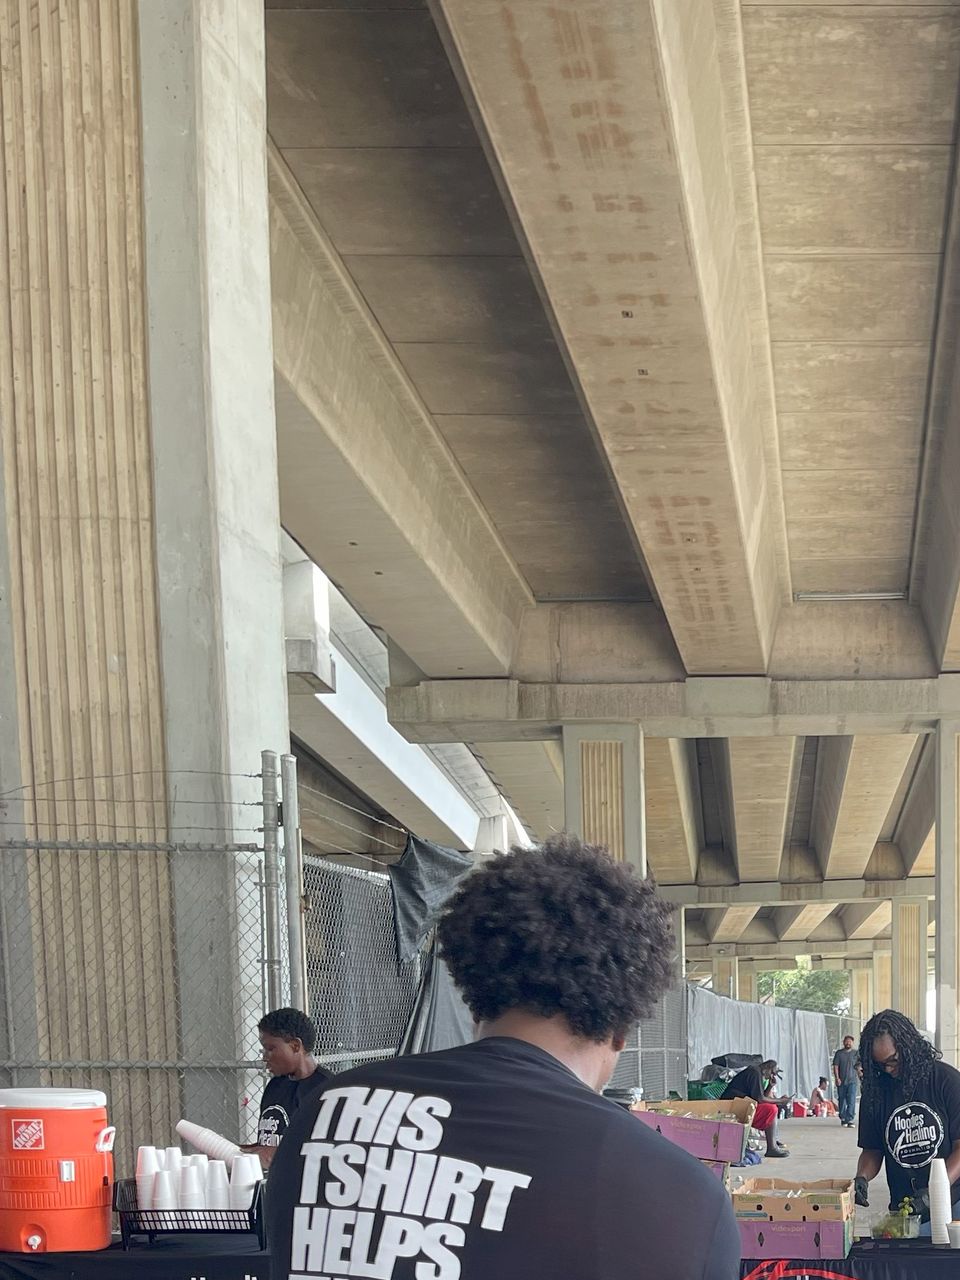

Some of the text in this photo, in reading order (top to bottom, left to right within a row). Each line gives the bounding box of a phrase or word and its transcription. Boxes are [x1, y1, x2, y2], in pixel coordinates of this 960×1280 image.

[311, 1086, 452, 1152] THIS
[894, 1113, 925, 1131] Hoodies
[905, 1124, 937, 1143] Healing
[300, 1142, 533, 1232] TSHIRT
